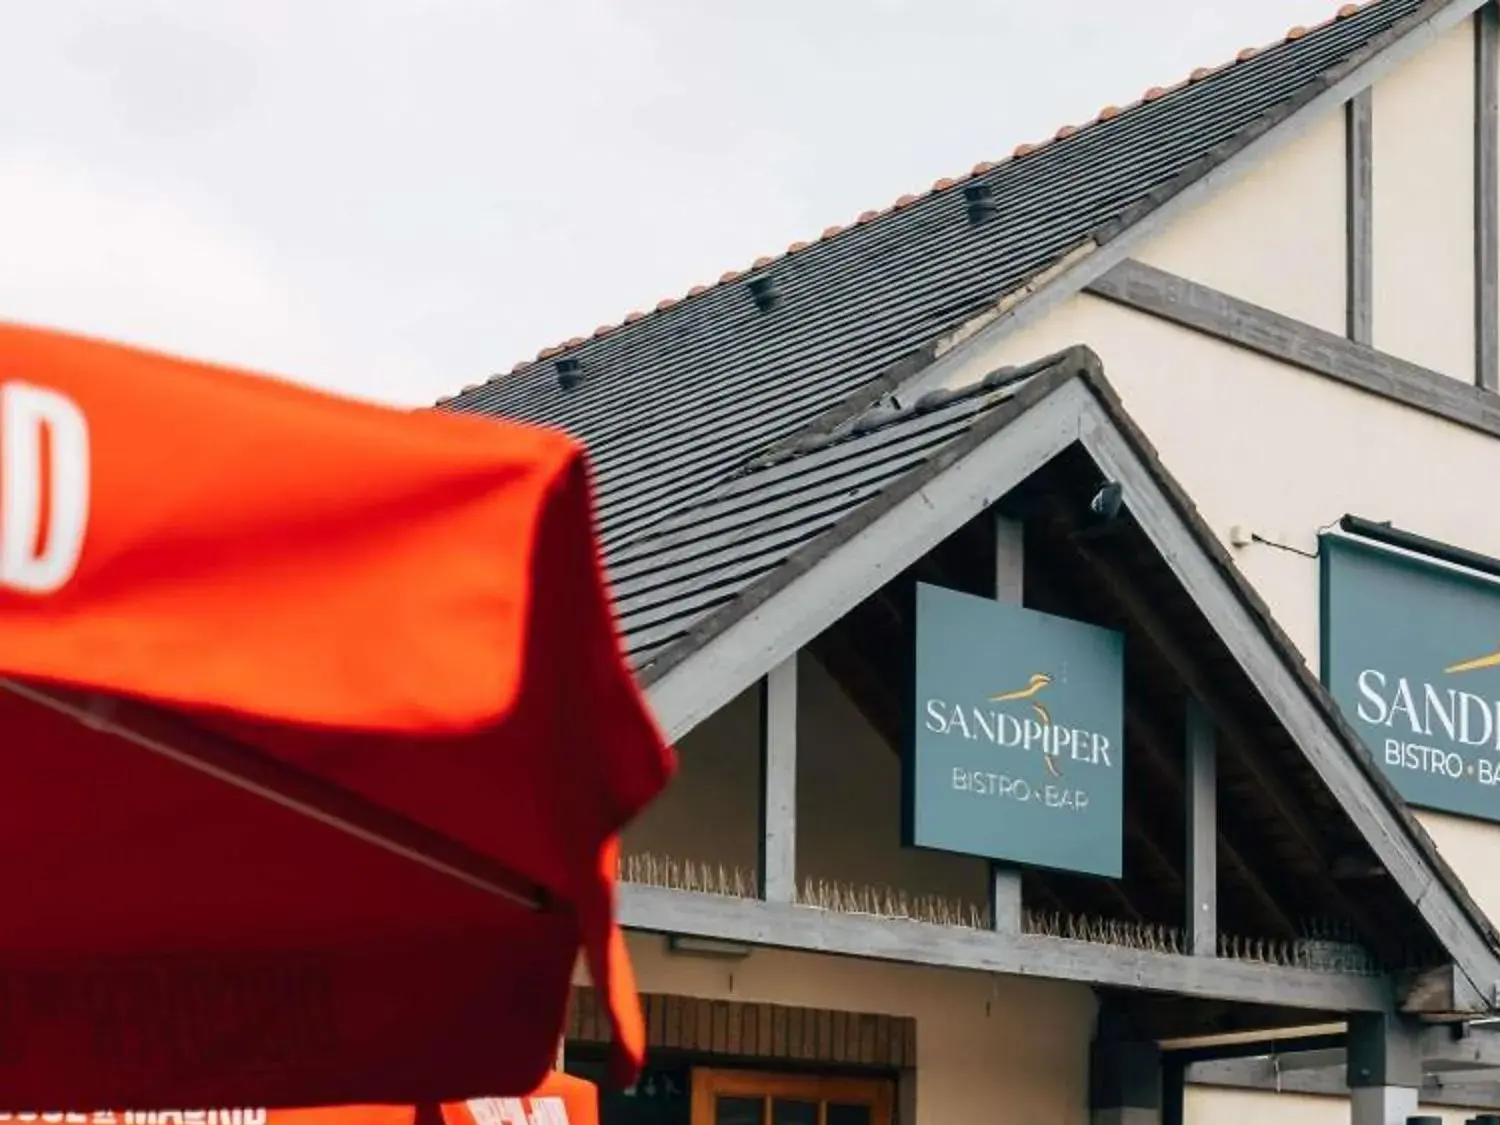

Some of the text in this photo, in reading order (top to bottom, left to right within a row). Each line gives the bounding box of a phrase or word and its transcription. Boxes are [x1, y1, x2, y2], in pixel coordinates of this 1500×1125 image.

[925, 698, 1112, 768] SANDPIPER
[1385, 738, 1464, 779] BISTRO
[952, 765, 1030, 803] BISTRO
